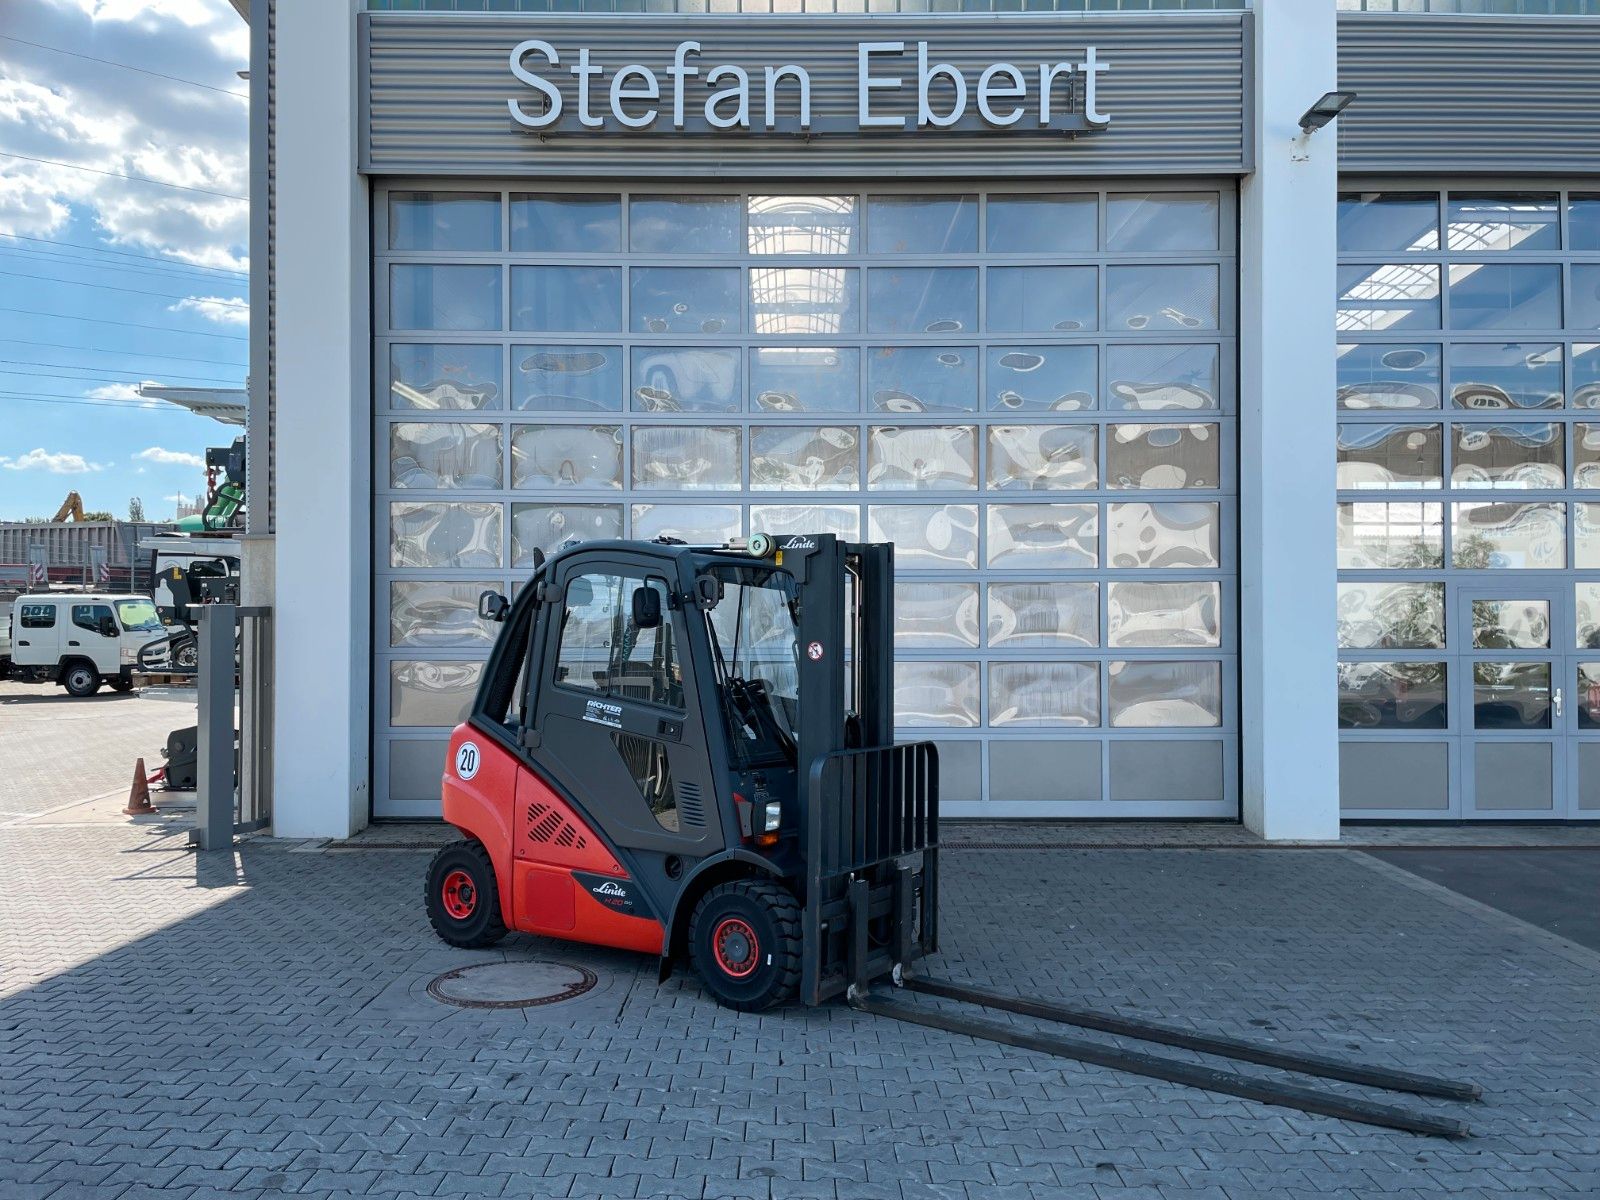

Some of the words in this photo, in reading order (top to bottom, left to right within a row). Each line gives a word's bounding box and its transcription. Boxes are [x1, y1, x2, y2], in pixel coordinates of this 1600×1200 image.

[507, 39, 811, 129] Stefan
[858, 41, 1111, 128] Ebert
[779, 535, 815, 549] Linde
[460, 748, 475, 772] 20
[593, 882, 626, 897] Linde
